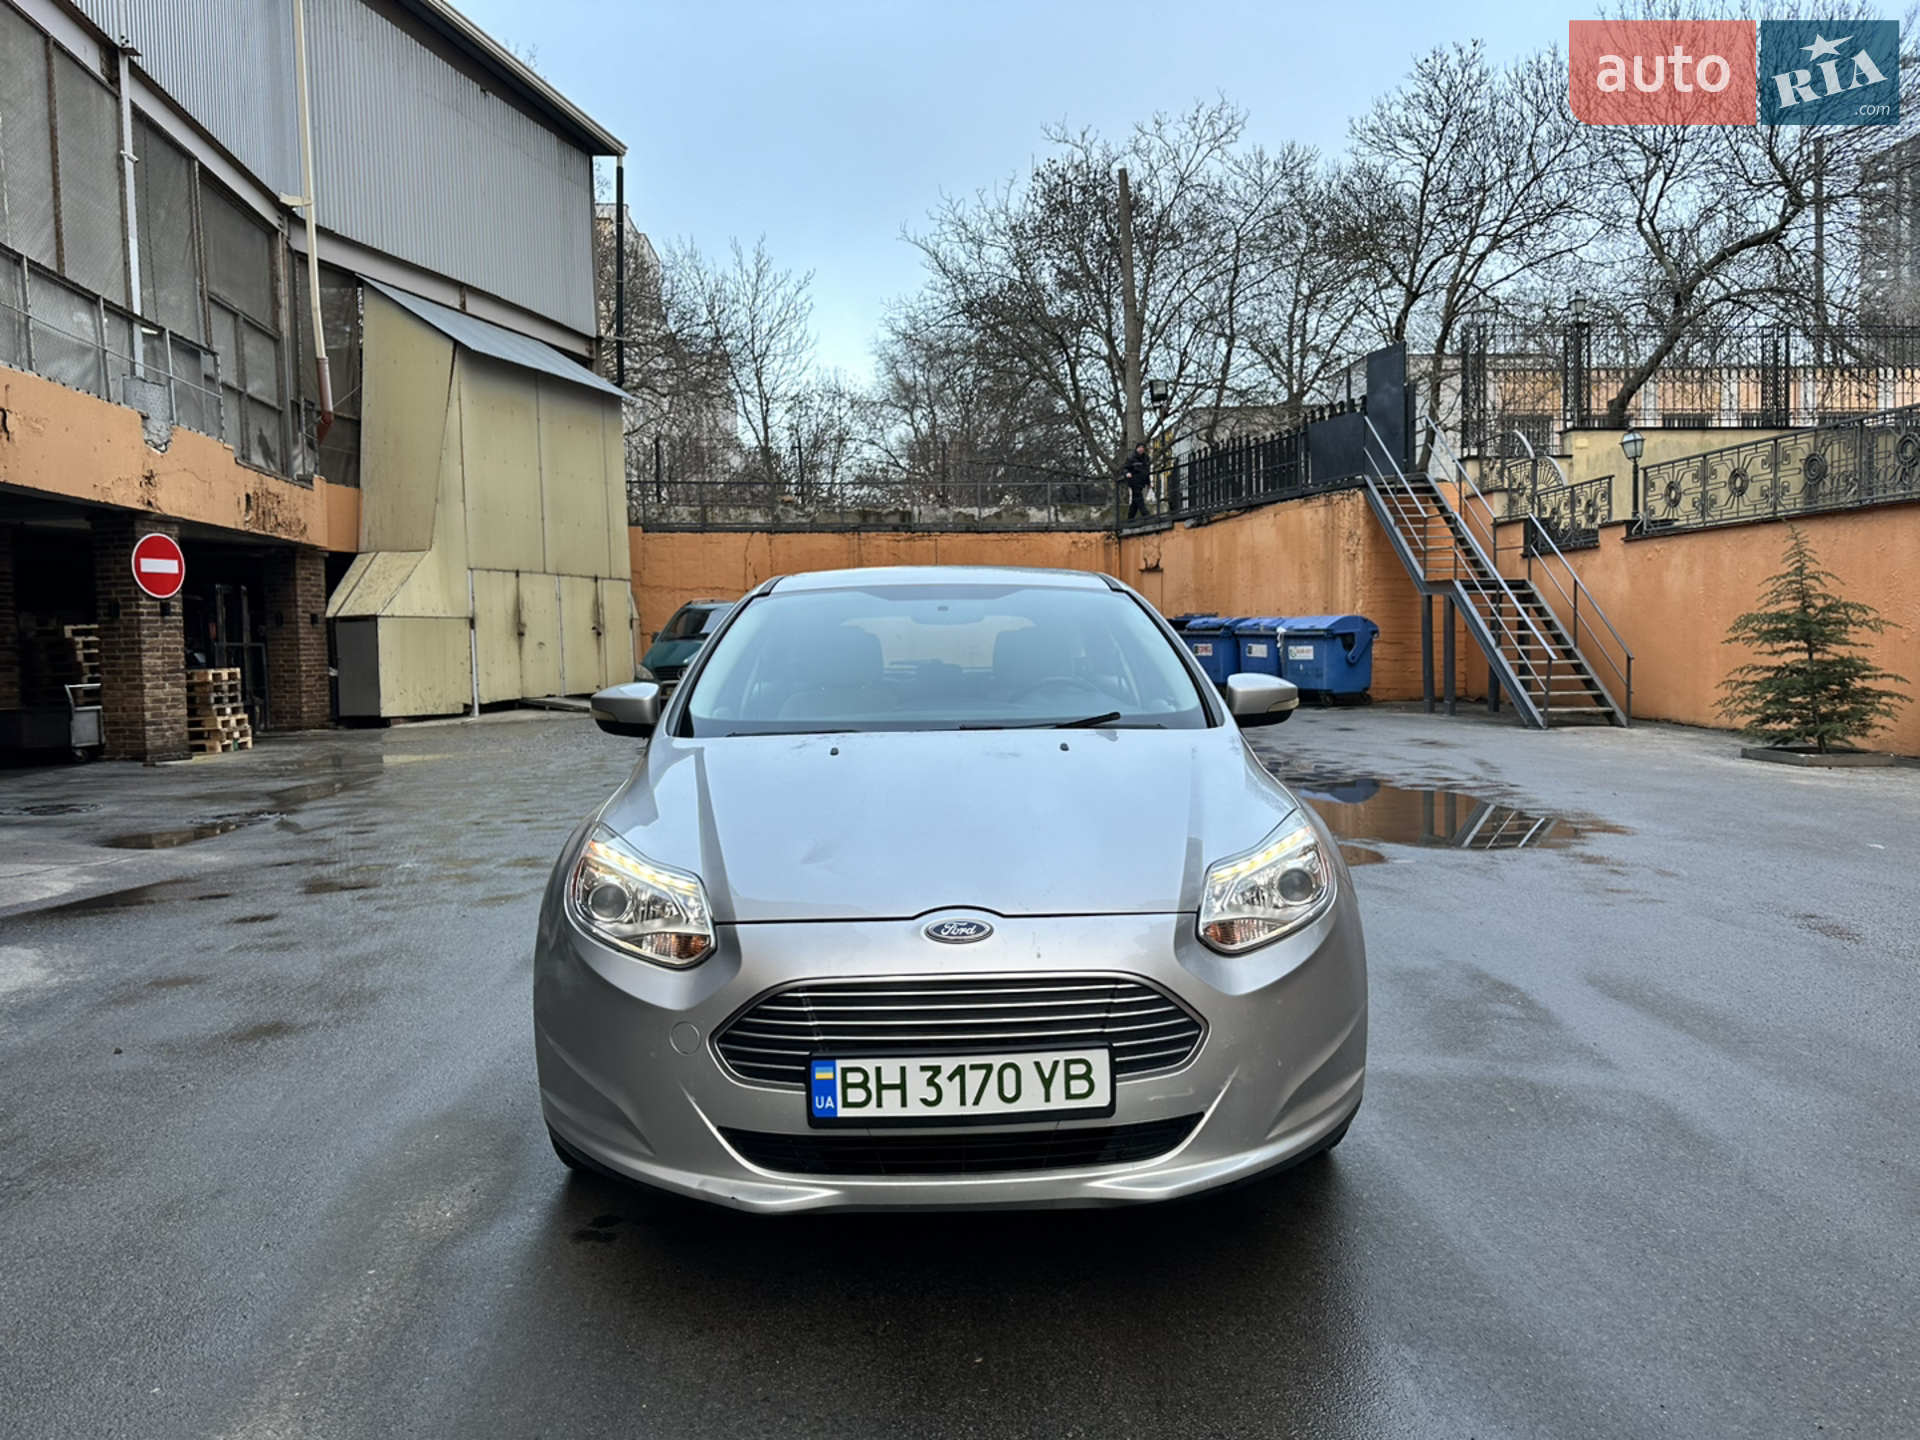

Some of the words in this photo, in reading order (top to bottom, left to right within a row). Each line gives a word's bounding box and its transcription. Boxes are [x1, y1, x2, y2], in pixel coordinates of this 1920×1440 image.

[940, 921, 977, 936] Ford
[840, 1066, 908, 1109] BH
[919, 1062, 1022, 1107] 3170
[1033, 1057, 1096, 1103] YB
[815, 1096, 834, 1109] UA
